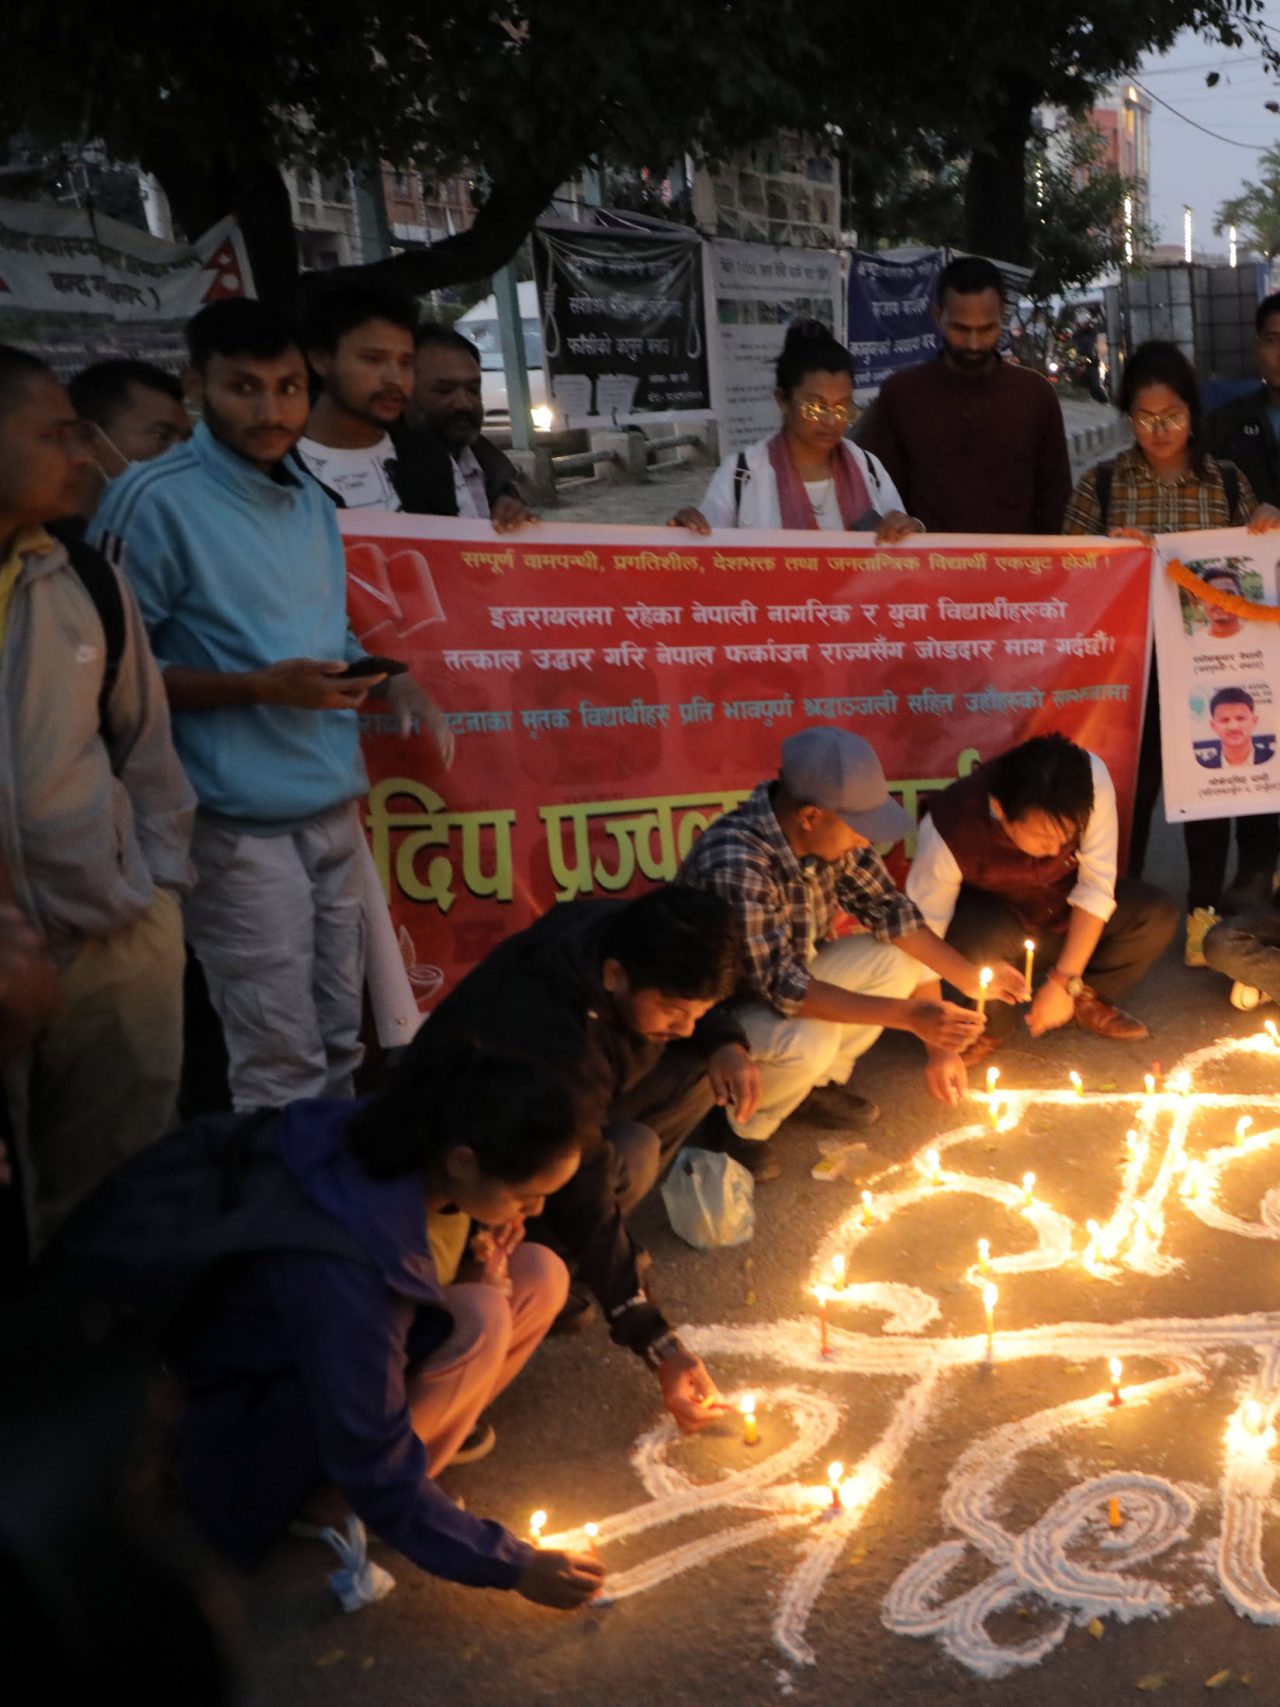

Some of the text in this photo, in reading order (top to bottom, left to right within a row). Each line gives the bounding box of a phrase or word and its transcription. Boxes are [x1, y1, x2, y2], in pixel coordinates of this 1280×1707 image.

[461, 550, 514, 574] सम्पूर्ण
[784, 555, 818, 571] तथा
[994, 555, 1053, 574] एकजुट
[488, 605, 614, 630] इजरायलमा
[623, 601, 682, 627] रहेका
[693, 599, 759, 625] नेपाली
[768, 598, 852, 625] नागरिक
[861, 604, 879, 625] र
[888, 603, 928, 628] युवा
[442, 649, 522, 671] तत्काल
[602, 640, 648, 669] गरि
[656, 641, 716, 666] नेपाल
[724, 637, 809, 664] फर्काउन
[914, 635, 996, 662] जोडदार
[1003, 638, 1048, 657] माग
[441, 709, 514, 736] टनाका
[520, 708, 572, 740] मृतक
[678, 694, 714, 725] प्रति
[906, 687, 956, 716] सहित
[367, 778, 516, 912] दिप
